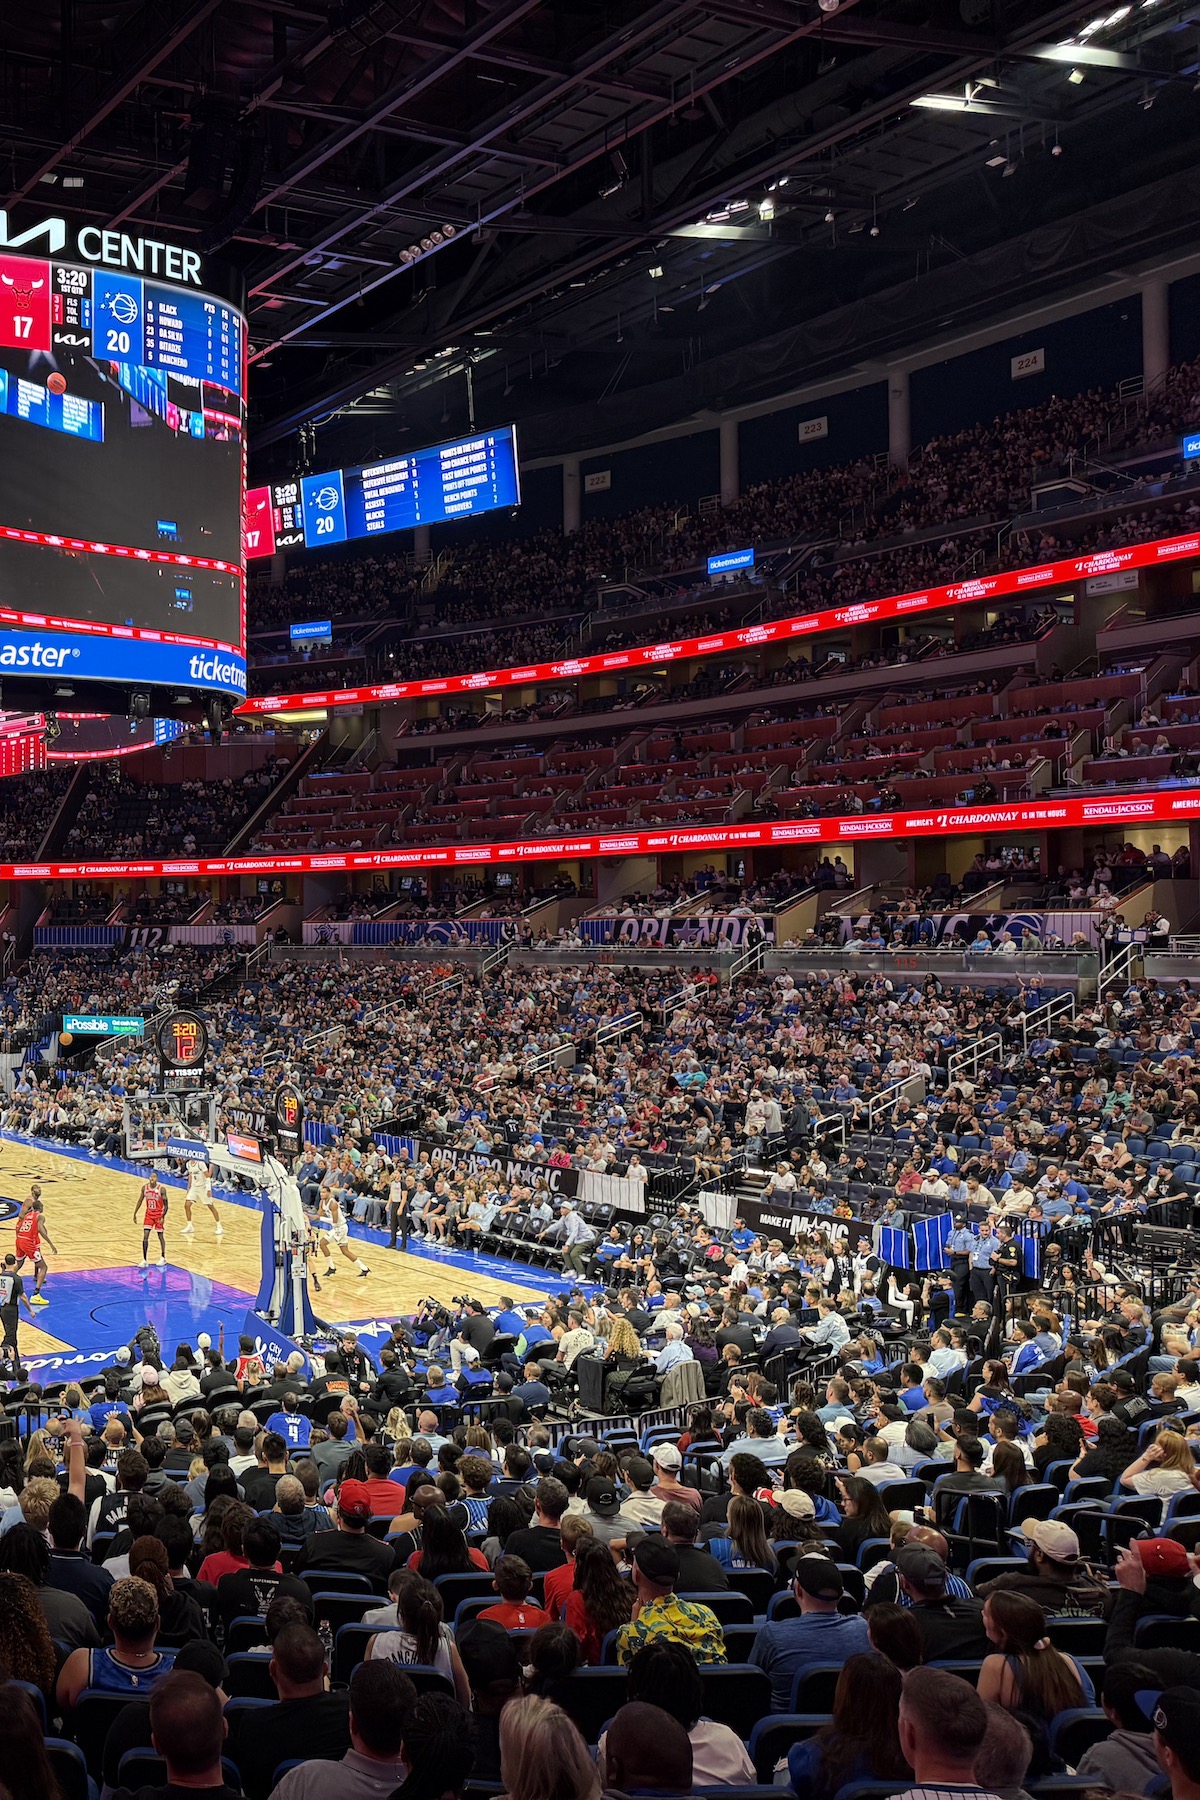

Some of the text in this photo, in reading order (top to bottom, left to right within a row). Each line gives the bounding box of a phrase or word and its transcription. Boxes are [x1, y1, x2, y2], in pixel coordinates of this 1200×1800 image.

[77, 226, 203, 285] CENTER
[56, 268, 87, 288] 3:20
[60, 284, 84, 295] 1ST QTR
[66, 298, 78, 307] FLS
[204, 302, 215, 314] PTS
[66, 306, 78, 316] TOL
[159, 303, 177, 316] BLACK
[13, 315, 33, 338] 17
[66, 315, 79, 325] CHL
[147, 313, 183, 330] 13 HOWARD
[146, 326, 155, 335] 23
[107, 329, 130, 353] 20
[146, 338, 155, 349] 35
[148, 351, 188, 368] 5 BANCHERO
[1018, 355, 1038, 371] 224
[804, 422, 822, 435] 223
[590, 476, 606, 486] 222
[275, 483, 297, 499] 3:20
[364, 498, 385, 510] ASSISTS
[365, 510, 385, 521] BLOCKS
[316, 516, 334, 535] 20
[366, 520, 385, 532] STEALS
[247, 531, 261, 548] 17
[710, 555, 751, 569] ticketmaster
[293, 625, 329, 635] ticketmaster
[906, 809, 1067, 828] AMERICA'S #1 CHARDONNAY THE HOUSE
[678, 832, 728, 844] CHARDONNAY
[380, 853, 422, 863] CHARDONNAY
[85, 865, 128, 873] CHARDONNAY
[130, 927, 162, 948] 112
[896, 956, 918, 969] 115
[72, 1018, 108, 1031] Possible
[172, 1023, 197, 1037] 3:20
[176, 1036, 195, 1060] 12
[175, 1068, 204, 1077] TISSOT
[286, 1109, 296, 1124] 12
[167, 1146, 206, 1160] THREATLOCKER
[760, 1213, 792, 1229] MAKE IT
[0, 1278, 7, 1288] 15
[269, 1342, 282, 1357] City
[289, 1424, 299, 1443] 4
